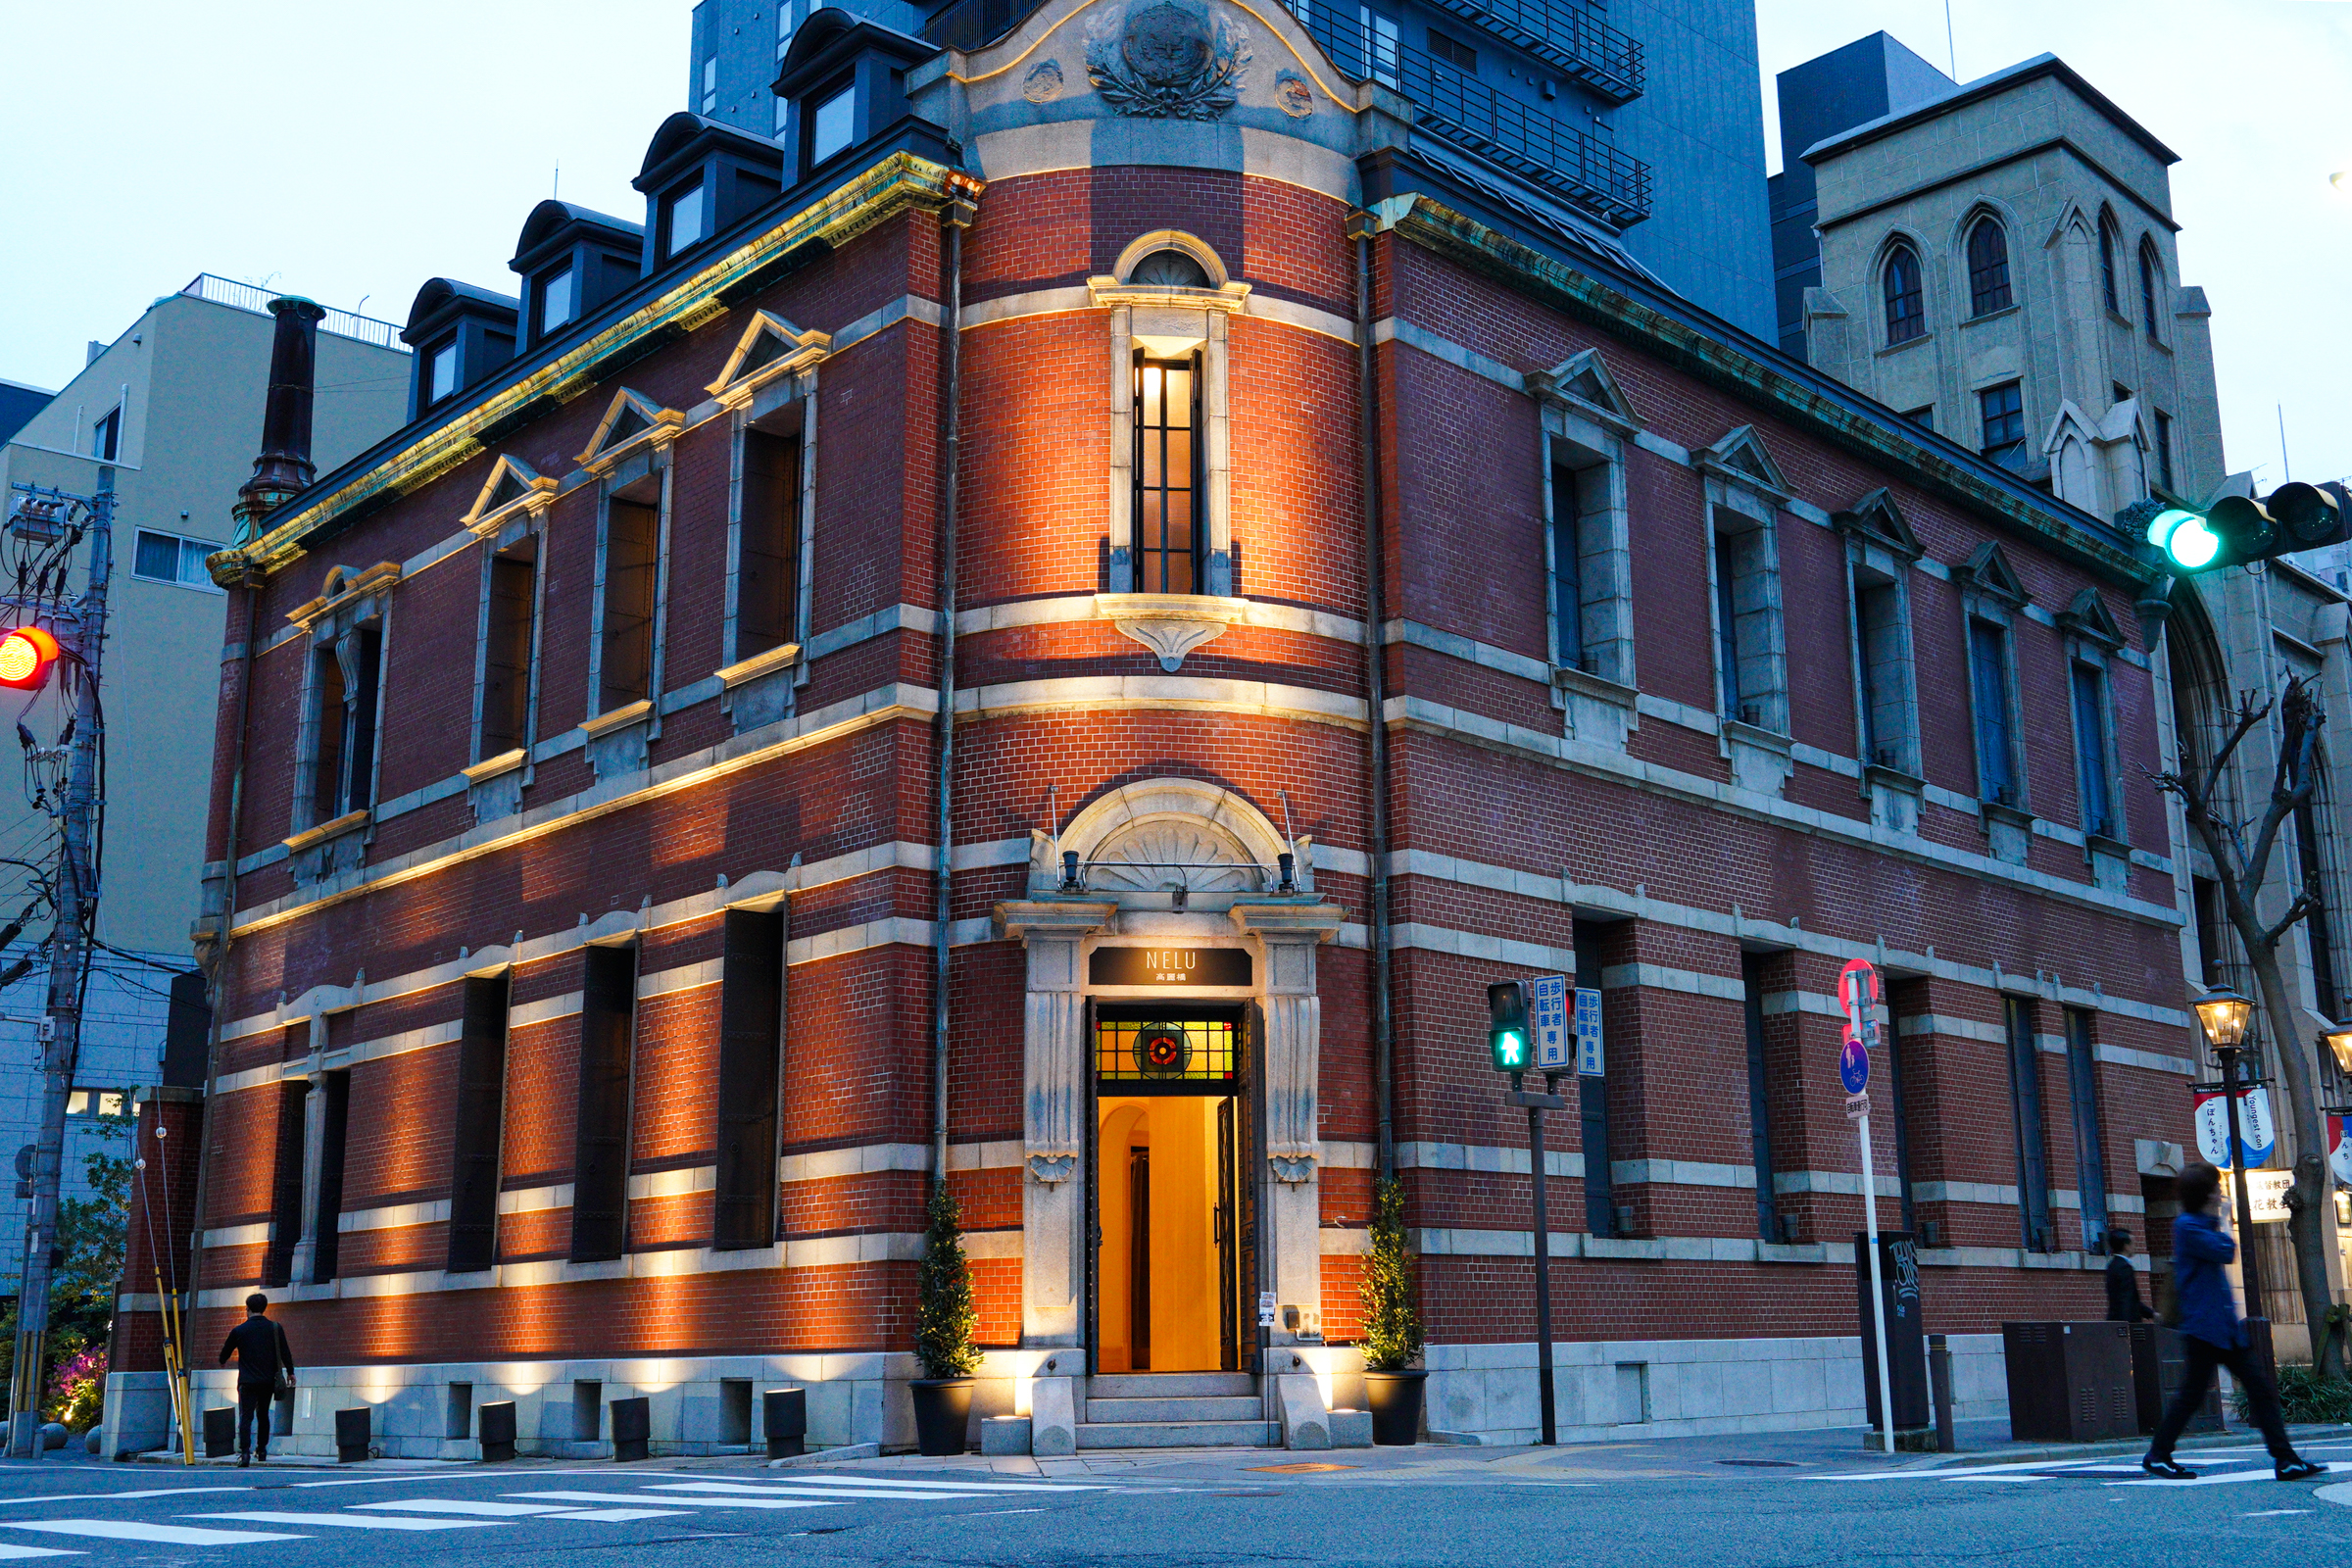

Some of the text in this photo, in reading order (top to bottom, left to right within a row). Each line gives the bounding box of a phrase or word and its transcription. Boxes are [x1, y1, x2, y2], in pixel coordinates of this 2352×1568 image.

[1147, 952, 1196, 969] NELU
[1155, 972, 1187, 981] 高麗橋
[1539, 983, 1550, 1028] 自転車
[1549, 981, 1562, 1027] 歩行者
[1578, 994, 1590, 1037] 自転車
[1589, 995, 1599, 1038] 歩行者
[1546, 1030, 1558, 1061] 専用
[1585, 1041, 1595, 1069] 専用
[2206, 1099, 2219, 1154] こぼんちゃん
[2249, 1095, 2261, 1132] Youngest
